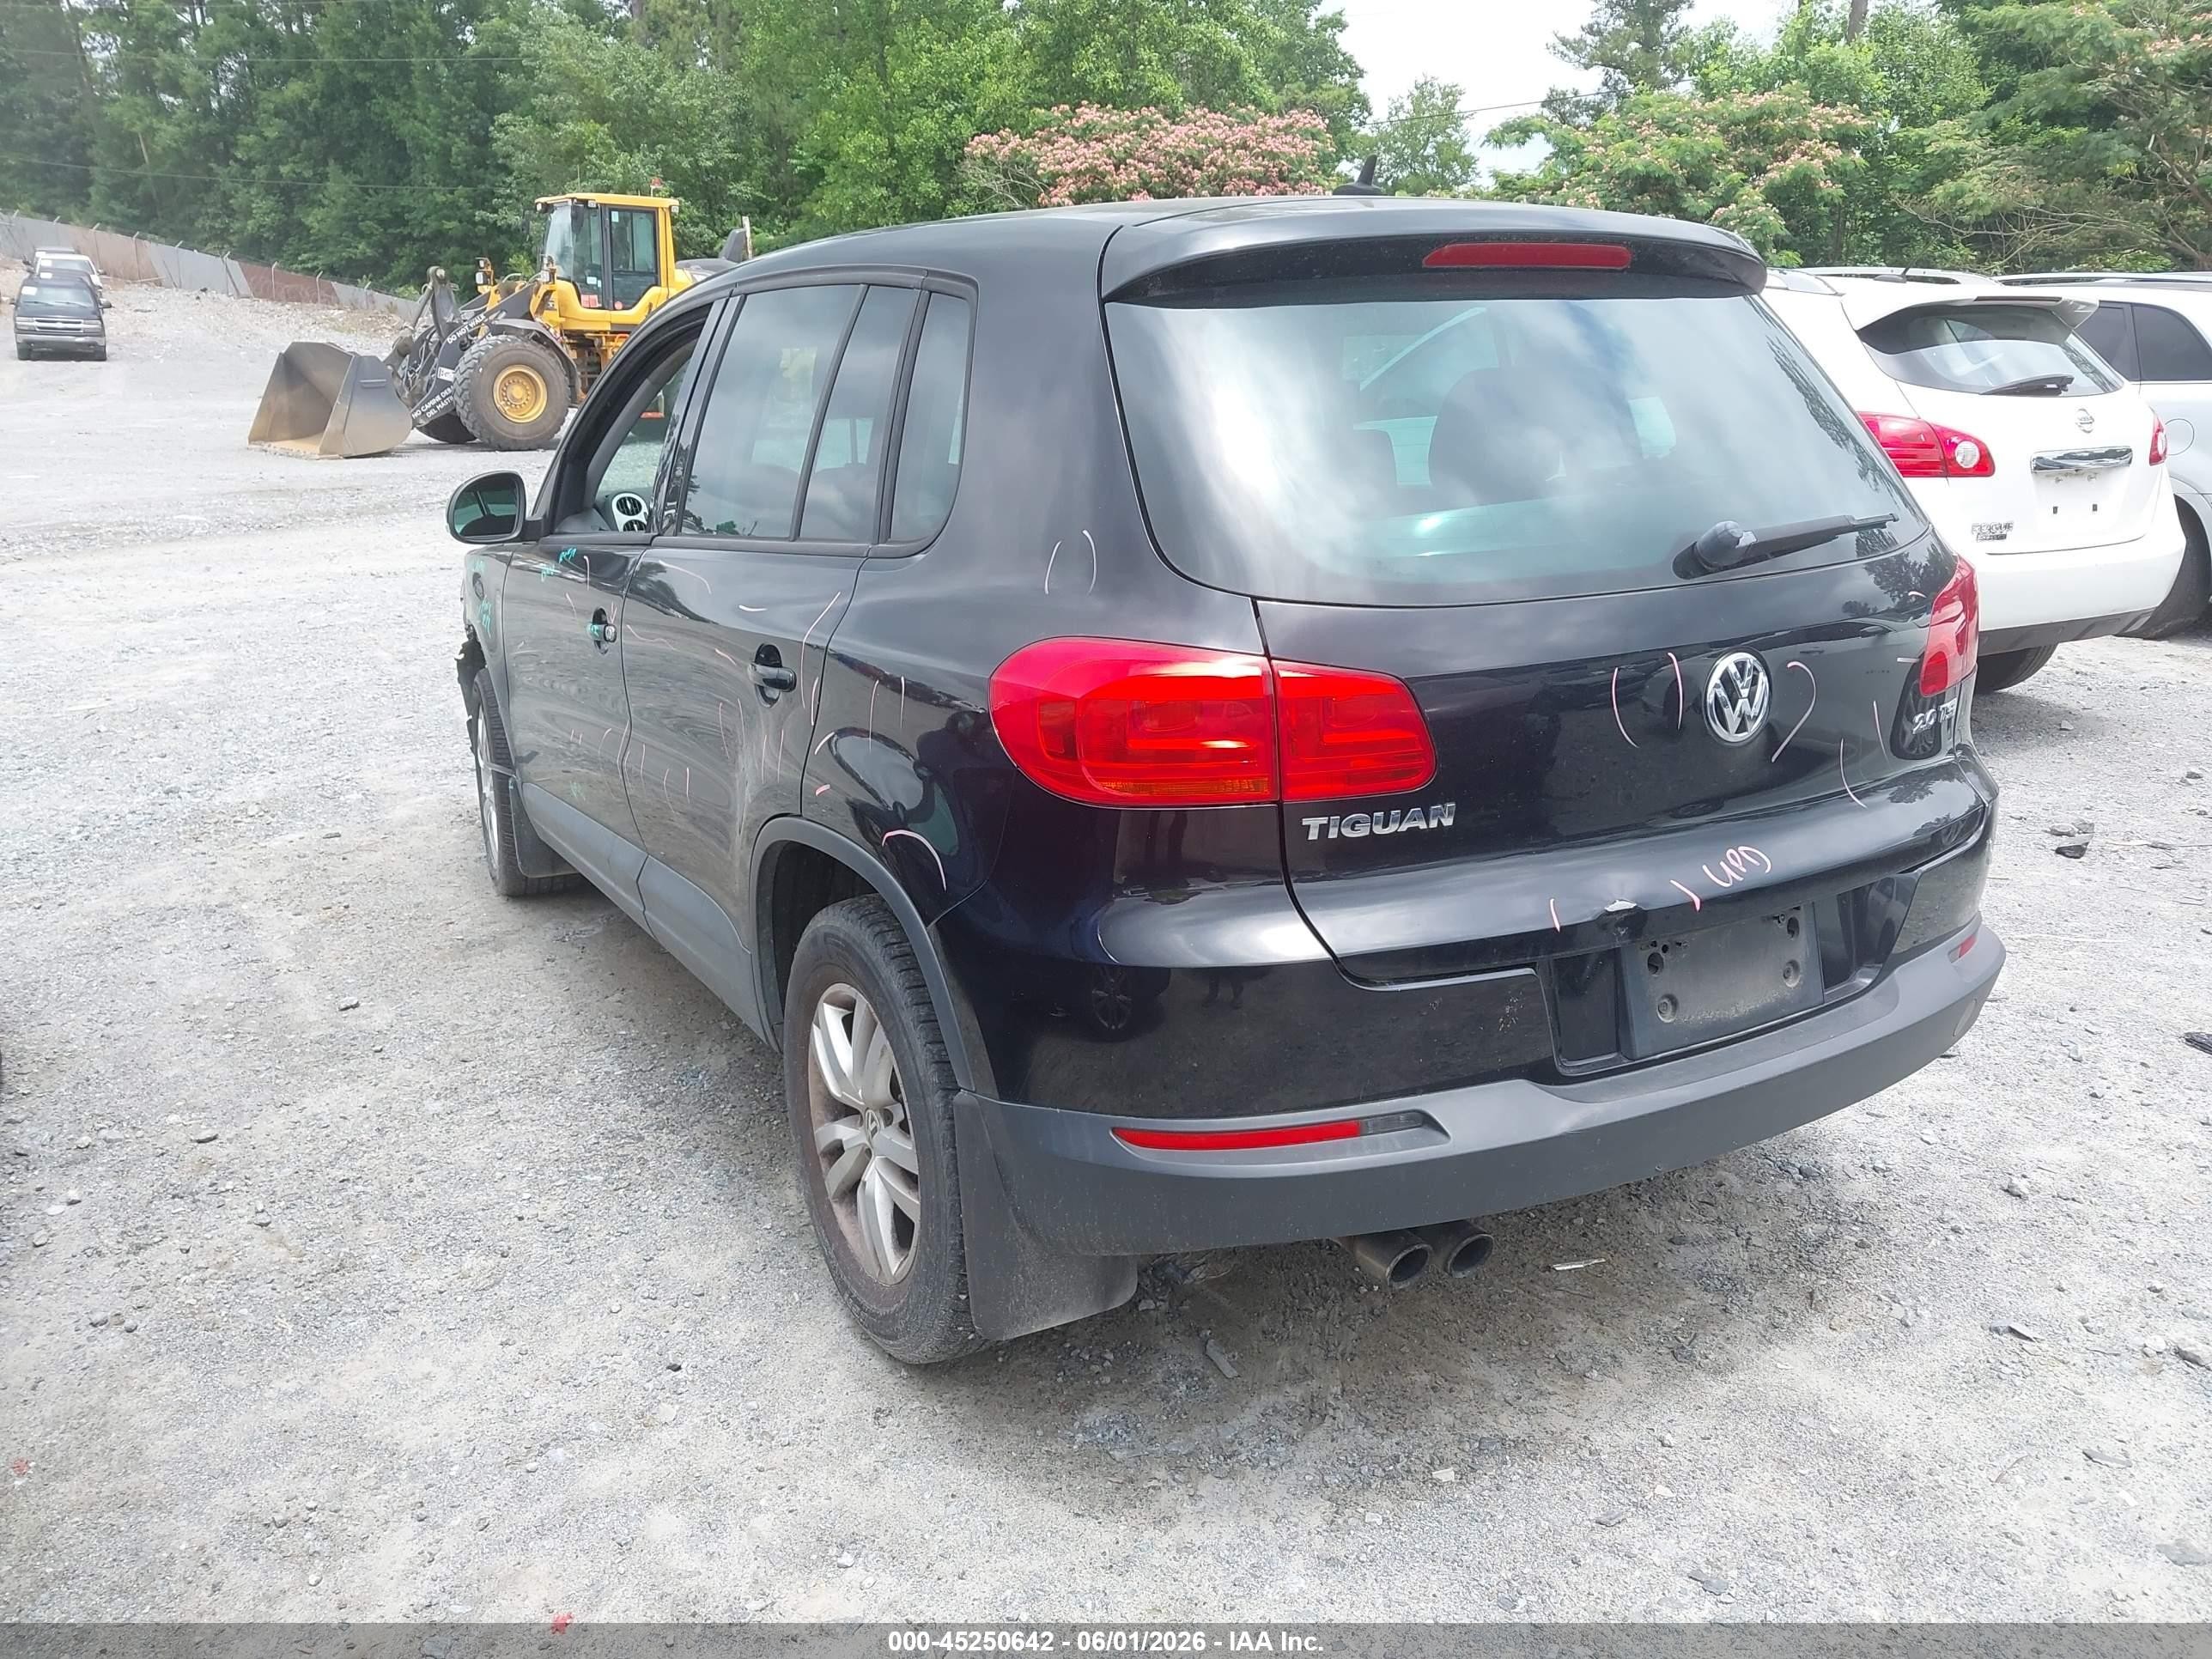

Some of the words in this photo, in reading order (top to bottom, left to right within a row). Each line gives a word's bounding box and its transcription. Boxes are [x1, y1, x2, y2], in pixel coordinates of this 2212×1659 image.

[447, 333, 457, 344] DO
[456, 325, 470, 337] NOT
[412, 410, 422, 419] NO
[441, 386, 453, 398] DEB
[1302, 803, 1456, 841] TIGUAN
